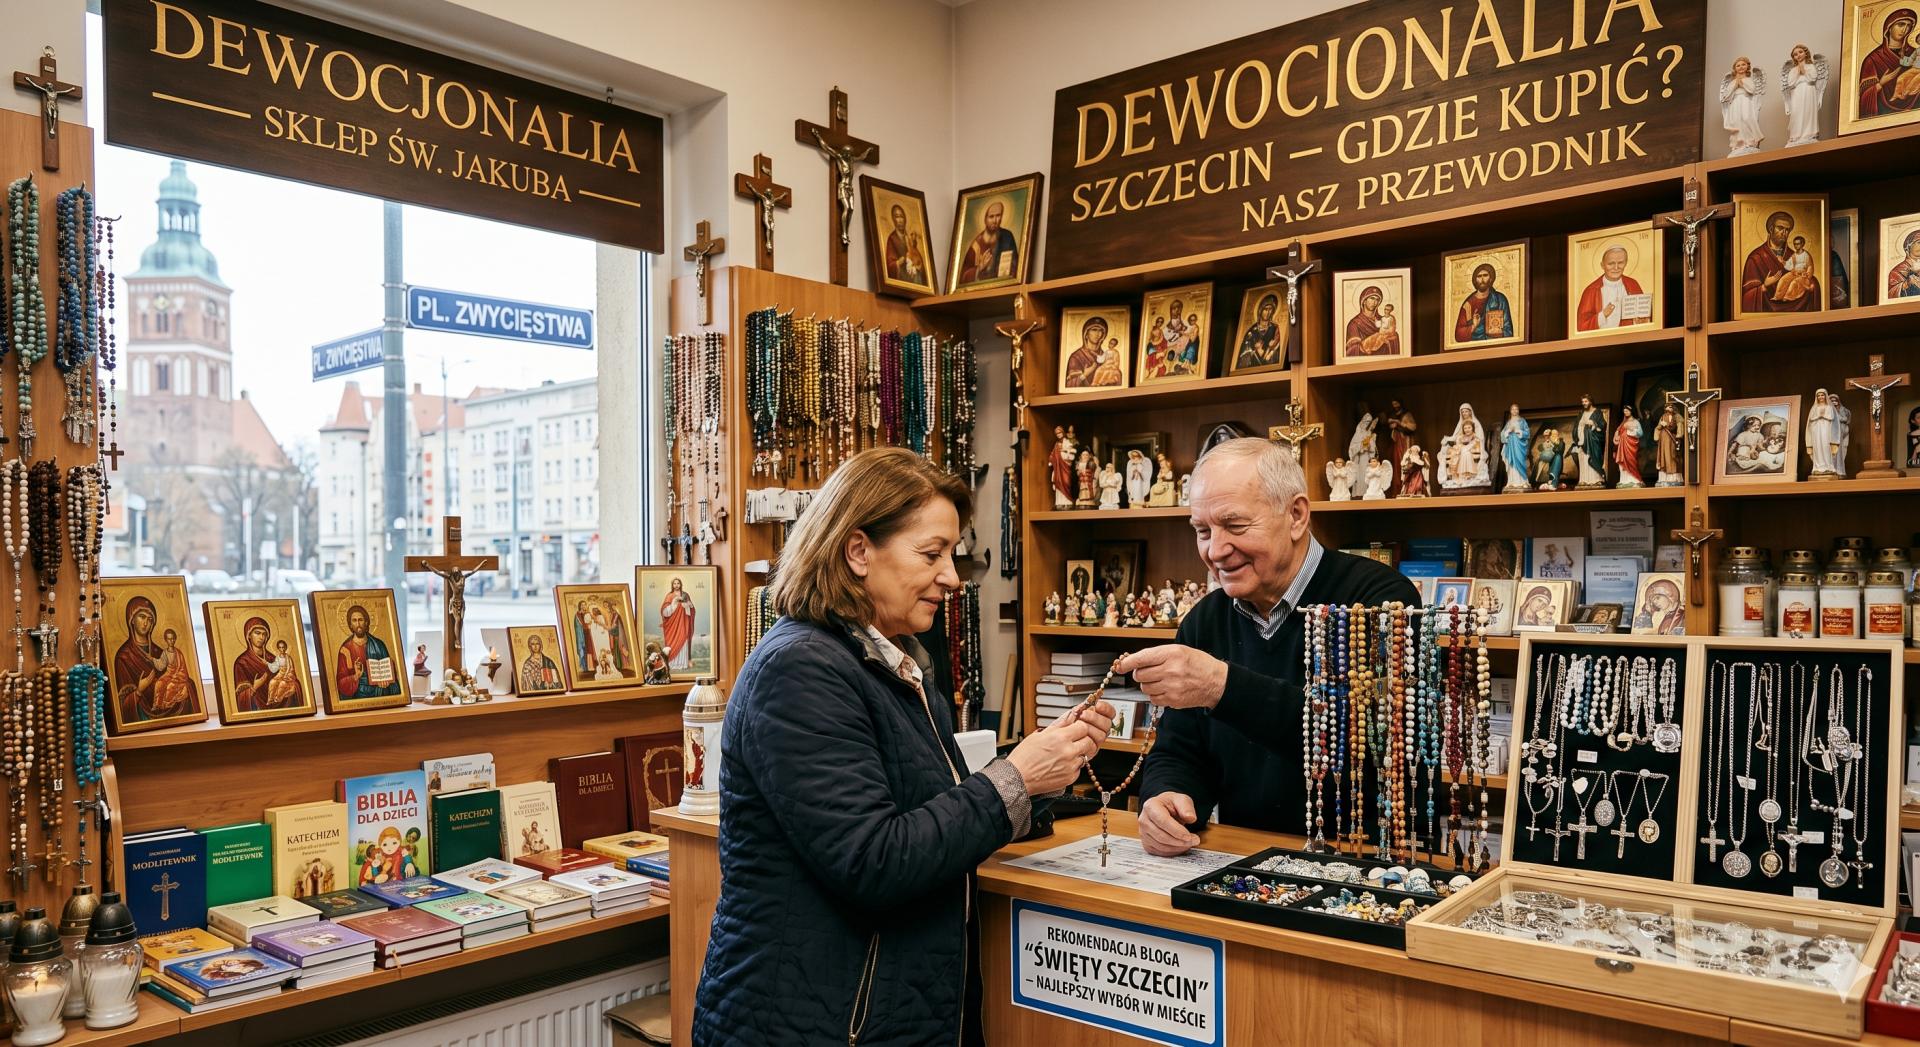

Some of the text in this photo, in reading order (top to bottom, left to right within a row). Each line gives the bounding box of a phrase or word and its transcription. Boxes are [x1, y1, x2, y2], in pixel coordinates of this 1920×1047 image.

[150, 1, 640, 173] DEWOCJONALIA
[1076, 0, 1663, 167] DEWOCIONALIA
[1072, 142, 1273, 221] SZCZECIN
[1337, 95, 1478, 164] GDZIE
[1499, 45, 1683, 131] KUPIĆ?
[265, 106, 571, 202] SKLEP ŚW. JAKUBA
[1242, 122, 1647, 231] NASZ PRZEWODNIK
[418, 296, 585, 339] PL. ZWYCIĘSTWA
[313, 339, 384, 373] PL. ZWYCIĘSTWA
[578, 772, 613, 787] BIBLIA
[578, 787, 592, 795] DLA
[357, 788, 417, 811] BIBLIA
[357, 806, 418, 824] DLA DZIECI
[450, 808, 492, 821] KATECHIZM
[288, 829, 341, 844] KATECHIZM
[133, 855, 196, 869] MODLITEWNIK
[213, 852, 262, 864] MODLITEWNIK
[1048, 927, 1179, 967] REKOMENDACJA BLOGA
[1037, 975, 1095, 1001] NAJLEPSZY
[1098, 990, 1139, 1012] WYBÓR
[1143, 1001, 1154, 1015] W
[1158, 1004, 1205, 1028] MIEŚCIE
